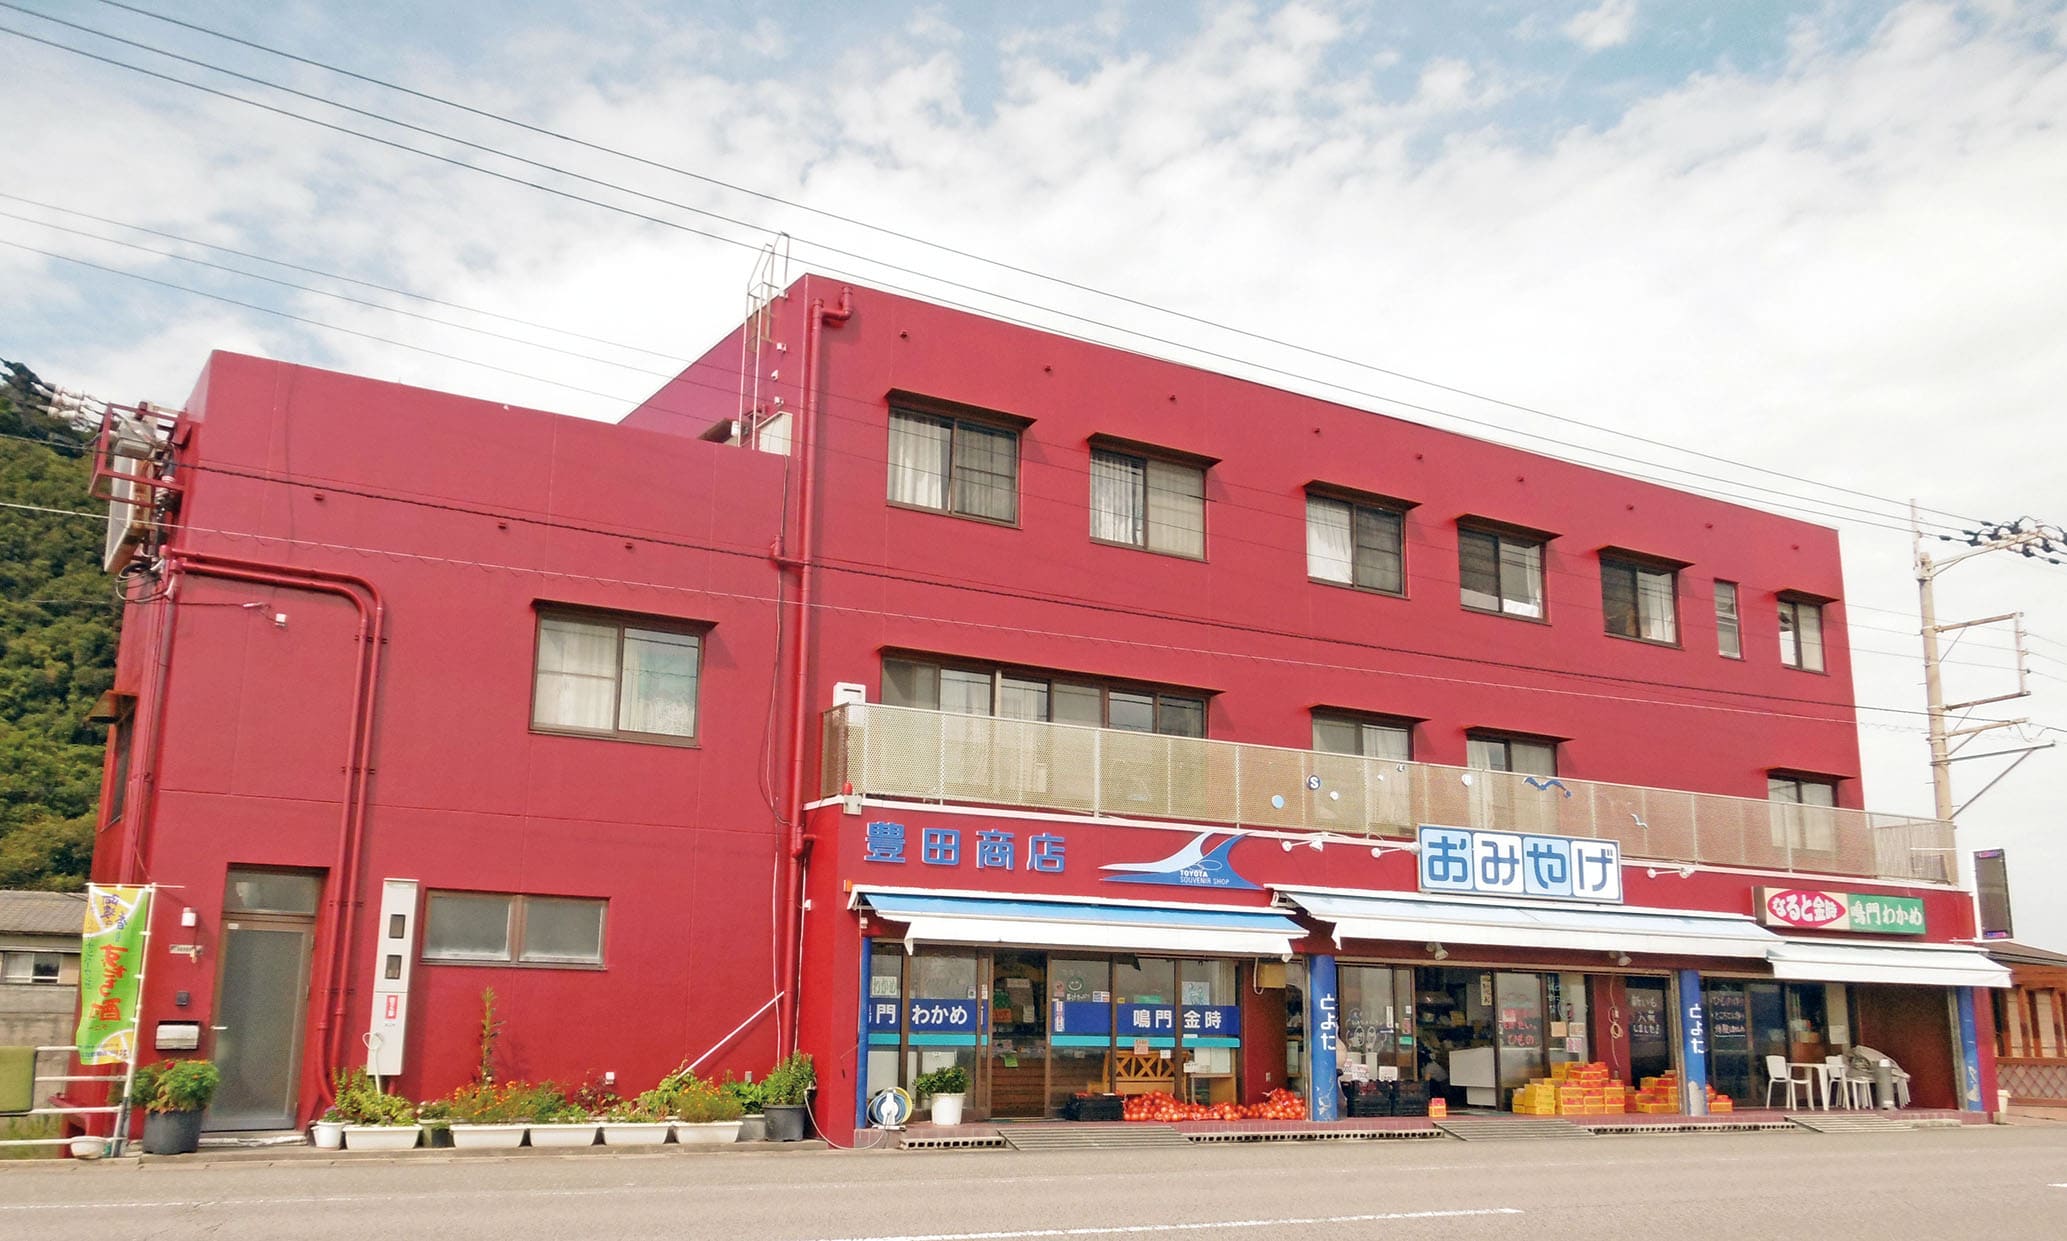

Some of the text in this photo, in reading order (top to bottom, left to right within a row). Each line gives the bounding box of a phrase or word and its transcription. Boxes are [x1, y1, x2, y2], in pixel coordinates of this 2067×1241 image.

[864, 821, 1066, 873] 豊田商店
[1180, 869, 1209, 878] TOYOTA
[1427, 836, 1614, 892] おみやげ
[1180, 876, 1212, 885] SOUVENIR
[1772, 894, 1838, 922] なると金時
[1850, 901, 1924, 926] 鳴門わかめ
[868, 1003, 897, 1024] 門
[911, 1004, 968, 1025] わかめ
[1320, 993, 1337, 1051] とよた
[1689, 1003, 1705, 1054] とよた
